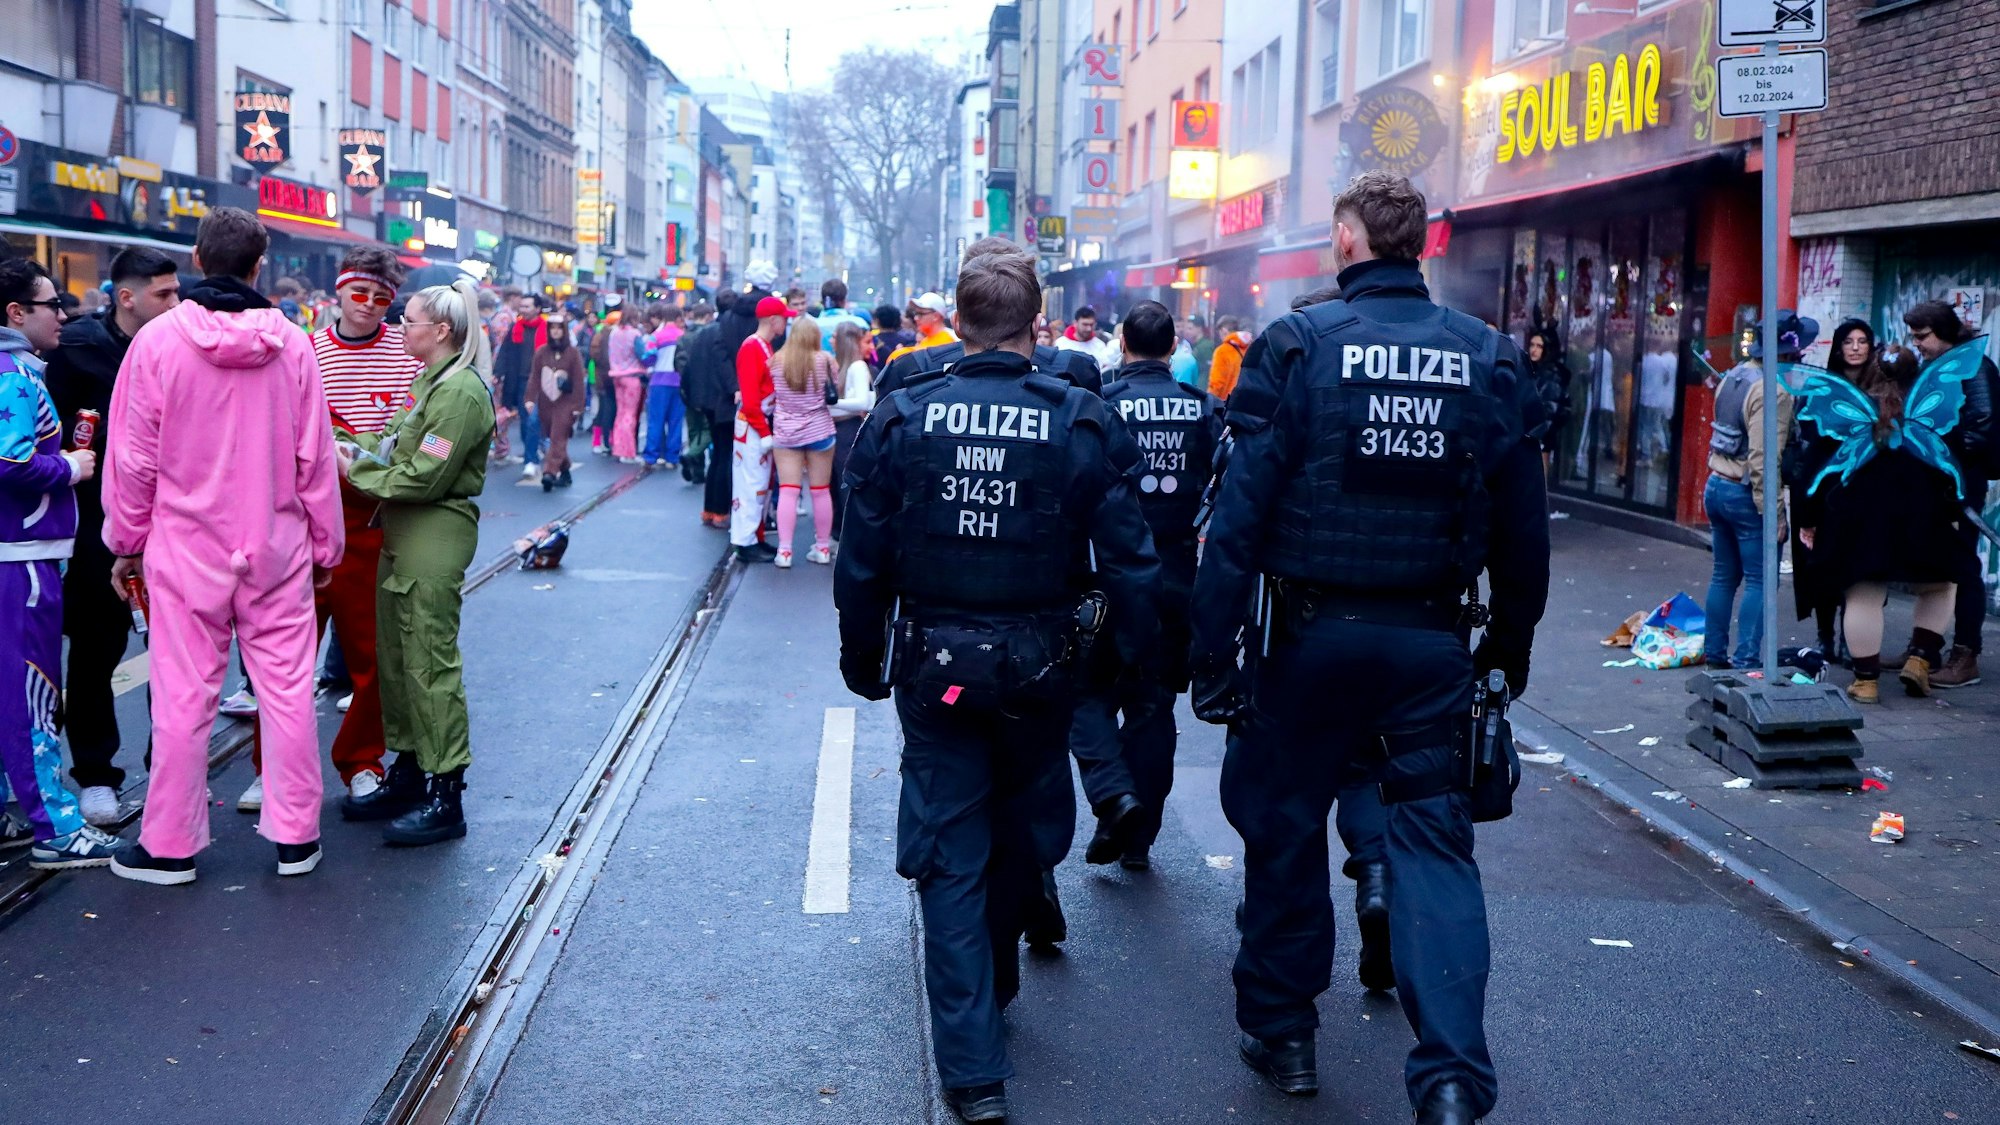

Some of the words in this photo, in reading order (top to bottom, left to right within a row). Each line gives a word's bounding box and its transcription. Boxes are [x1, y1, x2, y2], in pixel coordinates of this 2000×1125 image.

[1737, 65, 1793, 77] 08.02.2024
[1756, 80, 1772, 89] bis
[1497, 70, 1578, 163] SOUL
[1584, 43, 1661, 143] BAR
[1737, 91, 1794, 103] 12.02.2024
[243, 146, 283, 162] BAR
[1341, 344, 1471, 387] POLIZEI
[924, 402, 1050, 440] POLIZEI
[1120, 398, 1203, 422] POLIZEI
[1368, 394, 1443, 426] NRW
[1137, 431, 1185, 450] NRW
[1360, 428, 1445, 459] 31433
[956, 445, 1006, 473] NRW
[1143, 452, 1187, 471] 1431
[941, 475, 1018, 507] 31431
[958, 509, 999, 538] RH
